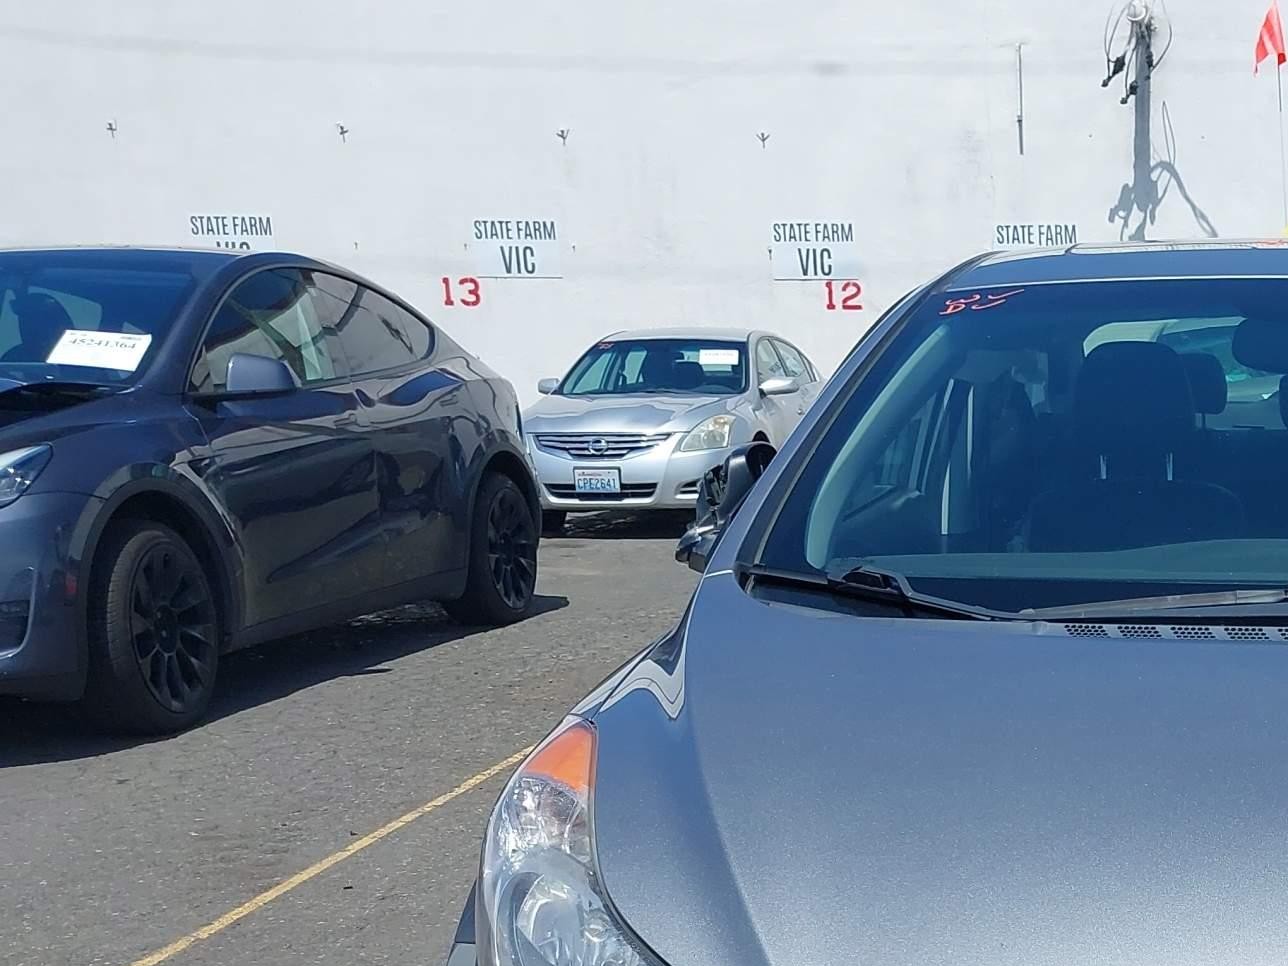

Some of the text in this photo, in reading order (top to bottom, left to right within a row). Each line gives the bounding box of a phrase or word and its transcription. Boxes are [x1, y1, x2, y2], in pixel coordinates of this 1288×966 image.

[190, 215, 273, 236] STATE FARM
[473, 220, 556, 241] STATE FARM
[773, 223, 854, 242] STATE FARM
[996, 224, 1077, 246] STATE FARM
[499, 246, 536, 274] VIC
[797, 247, 833, 276] VIC
[442, 277, 482, 307] 13
[825, 281, 863, 310] 12
